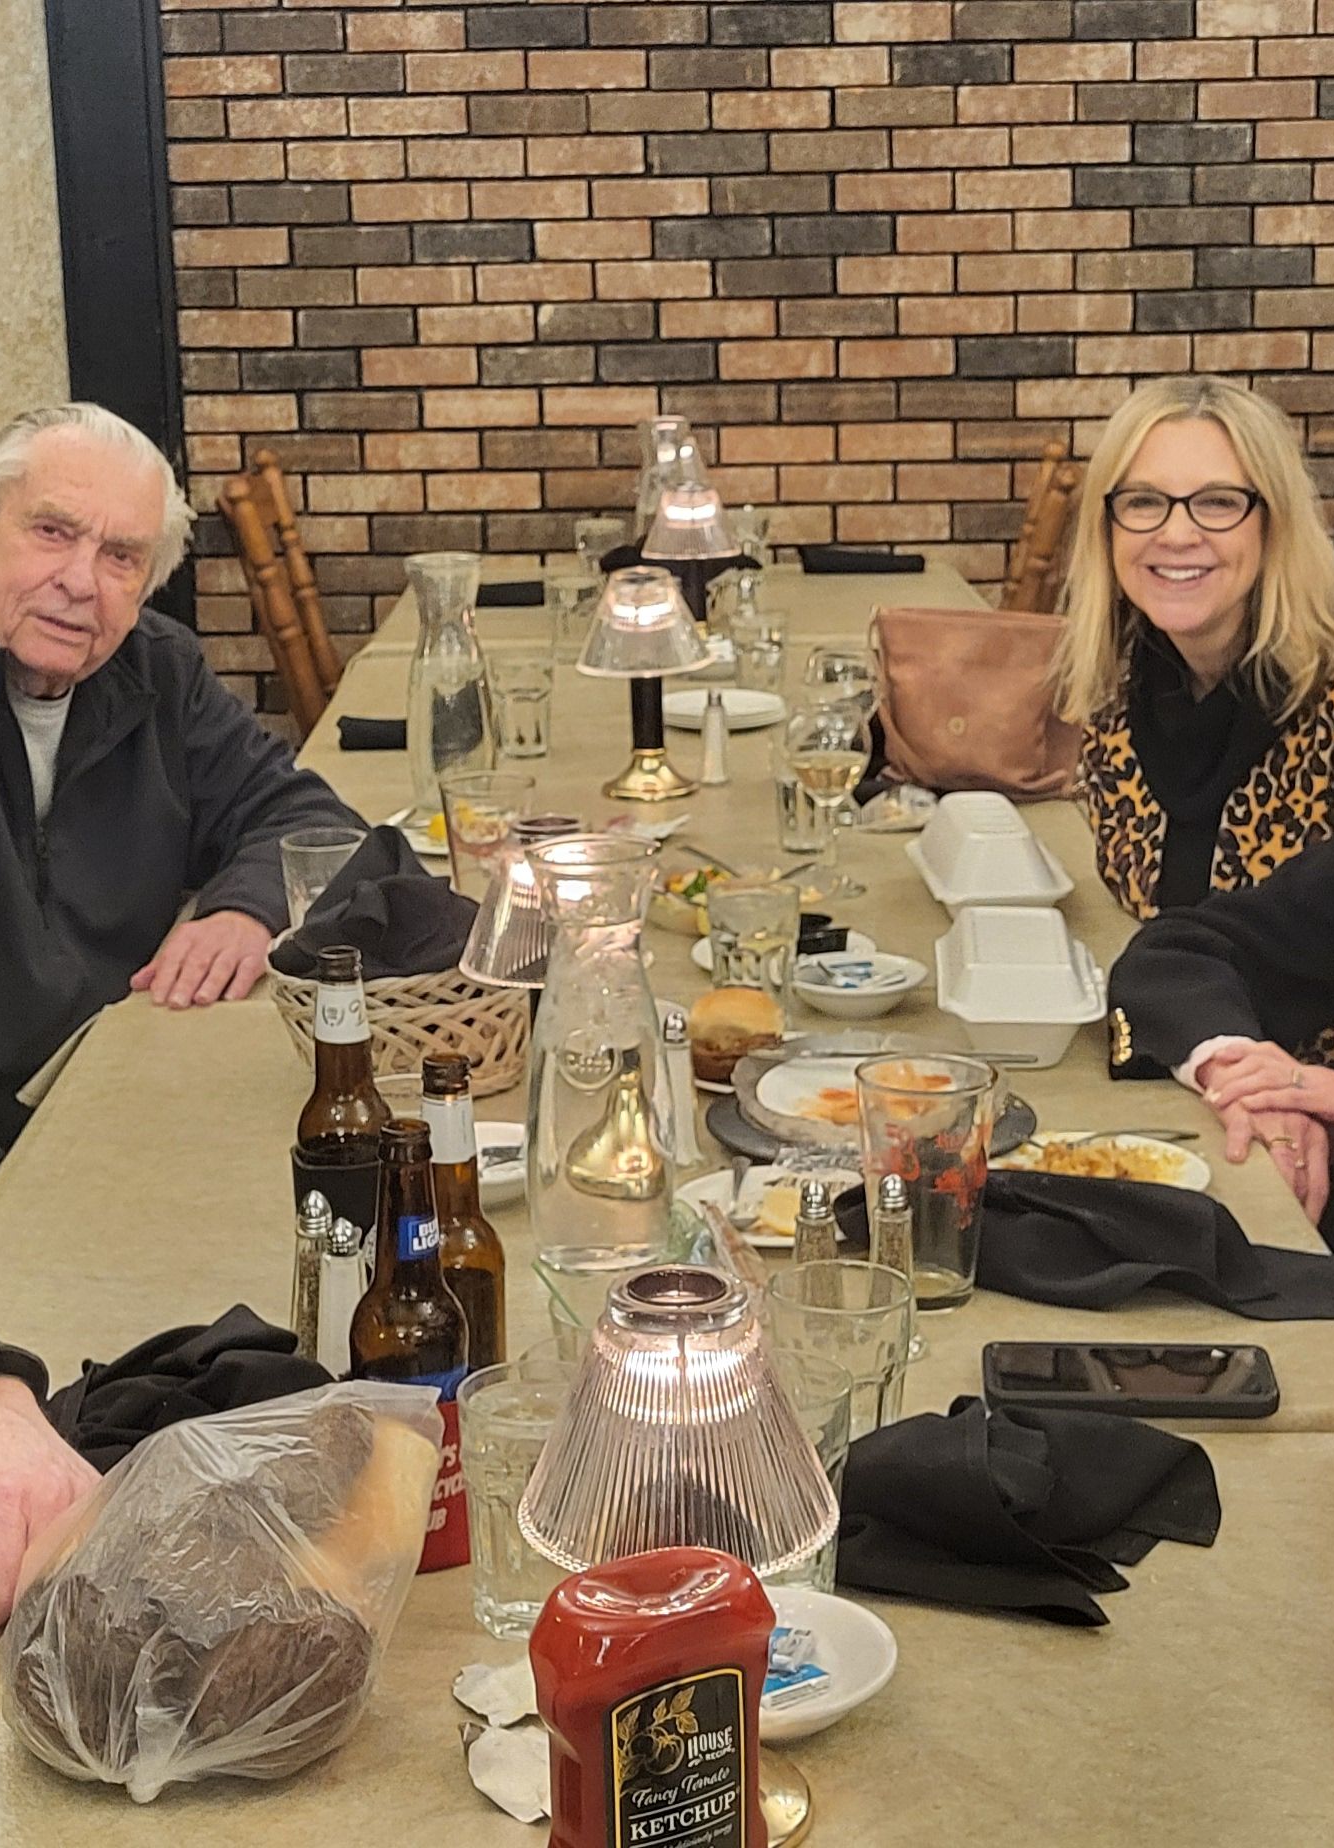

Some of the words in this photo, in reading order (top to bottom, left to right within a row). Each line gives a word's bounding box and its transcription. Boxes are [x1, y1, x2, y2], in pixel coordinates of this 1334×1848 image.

[413, 1232, 440, 1251] LIG
[419, 1220, 438, 1237] BU
[687, 1725, 733, 1760] HOUSE
[631, 1787, 679, 1808] Fancy
[681, 1766, 730, 1794] Tomato
[630, 1790, 736, 1841] KETCHUP
